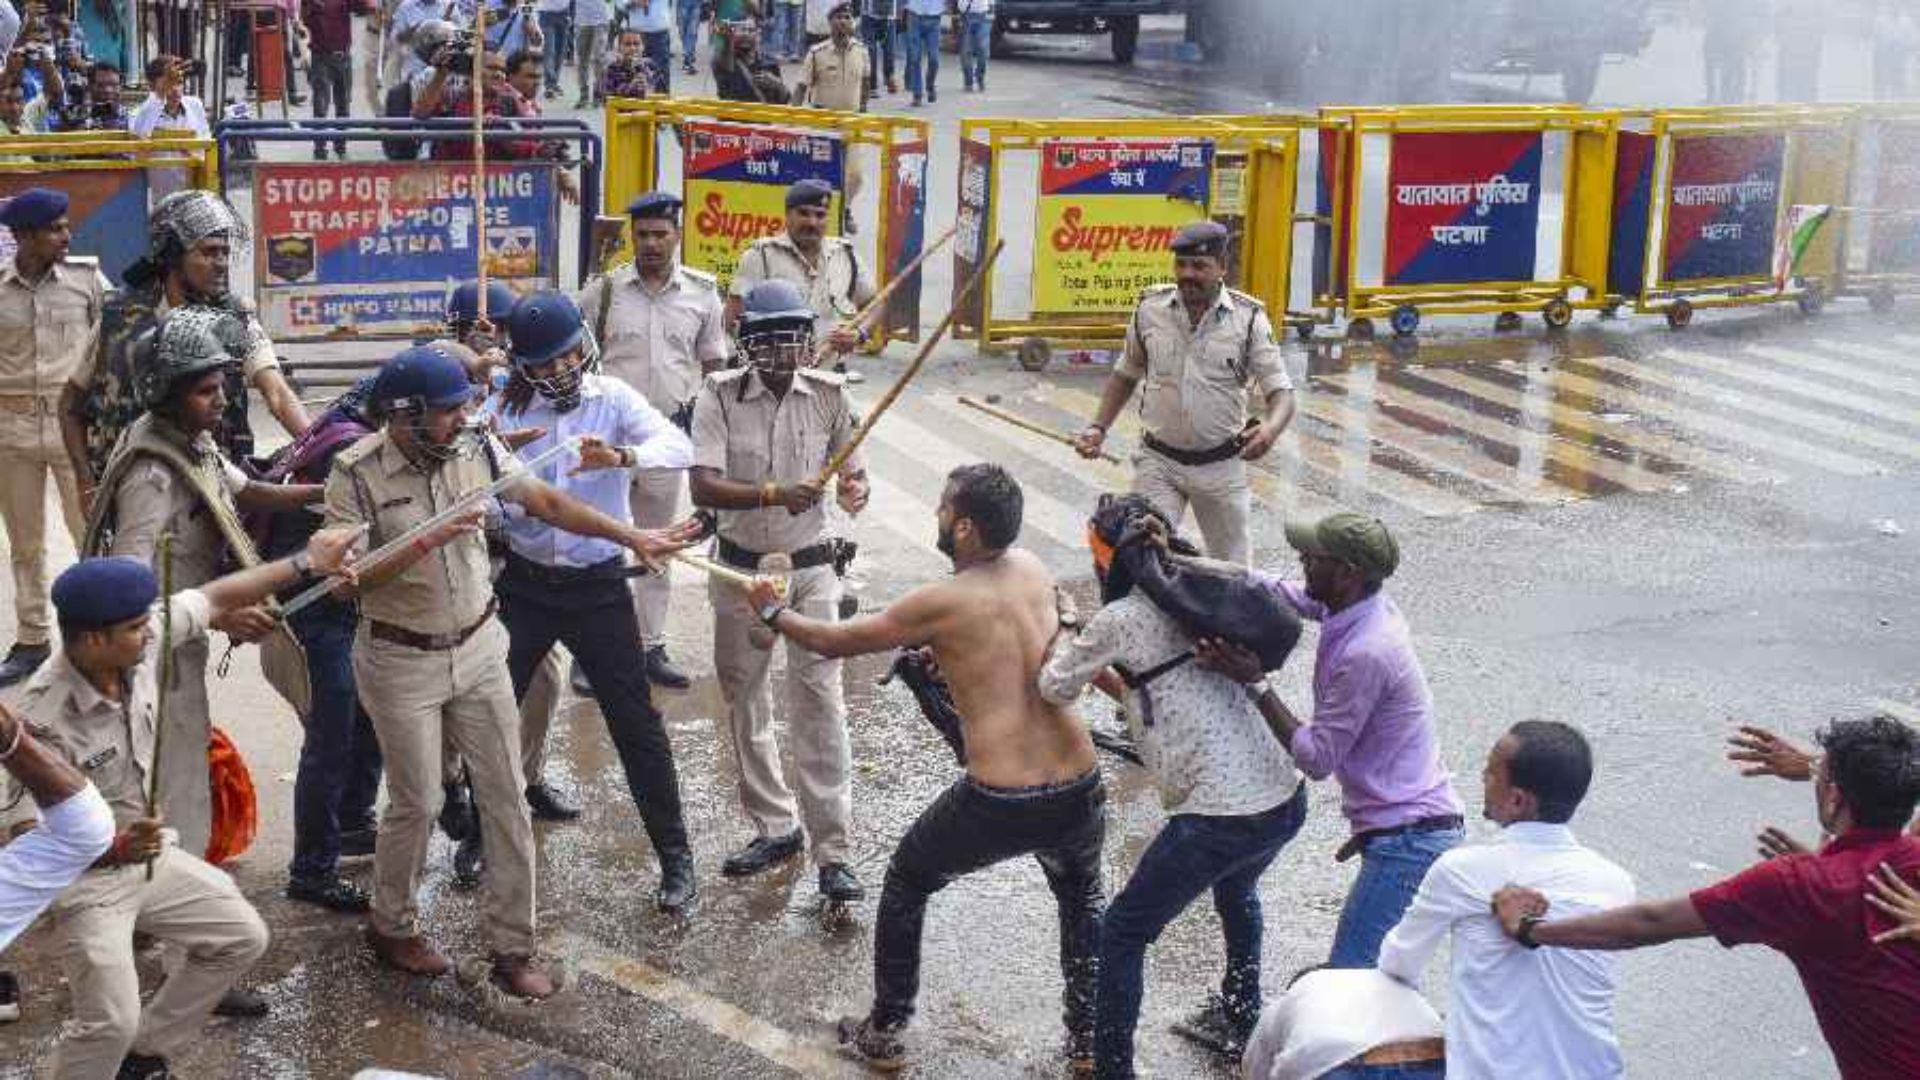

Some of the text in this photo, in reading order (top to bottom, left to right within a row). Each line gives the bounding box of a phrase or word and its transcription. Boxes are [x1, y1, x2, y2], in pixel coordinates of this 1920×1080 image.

[265, 178, 333, 204] STOP
[341, 177, 391, 201] FOR
[1395, 174, 1530, 216] यातायात पुलिस
[1672, 172, 1776, 212] यातायात पुलिस
[696, 192, 785, 249] Supre
[1051, 205, 1175, 262] Suprem
[1431, 225, 1490, 245] पटना
[1701, 224, 1742, 240] पटना
[359, 234, 443, 255] PATNA
